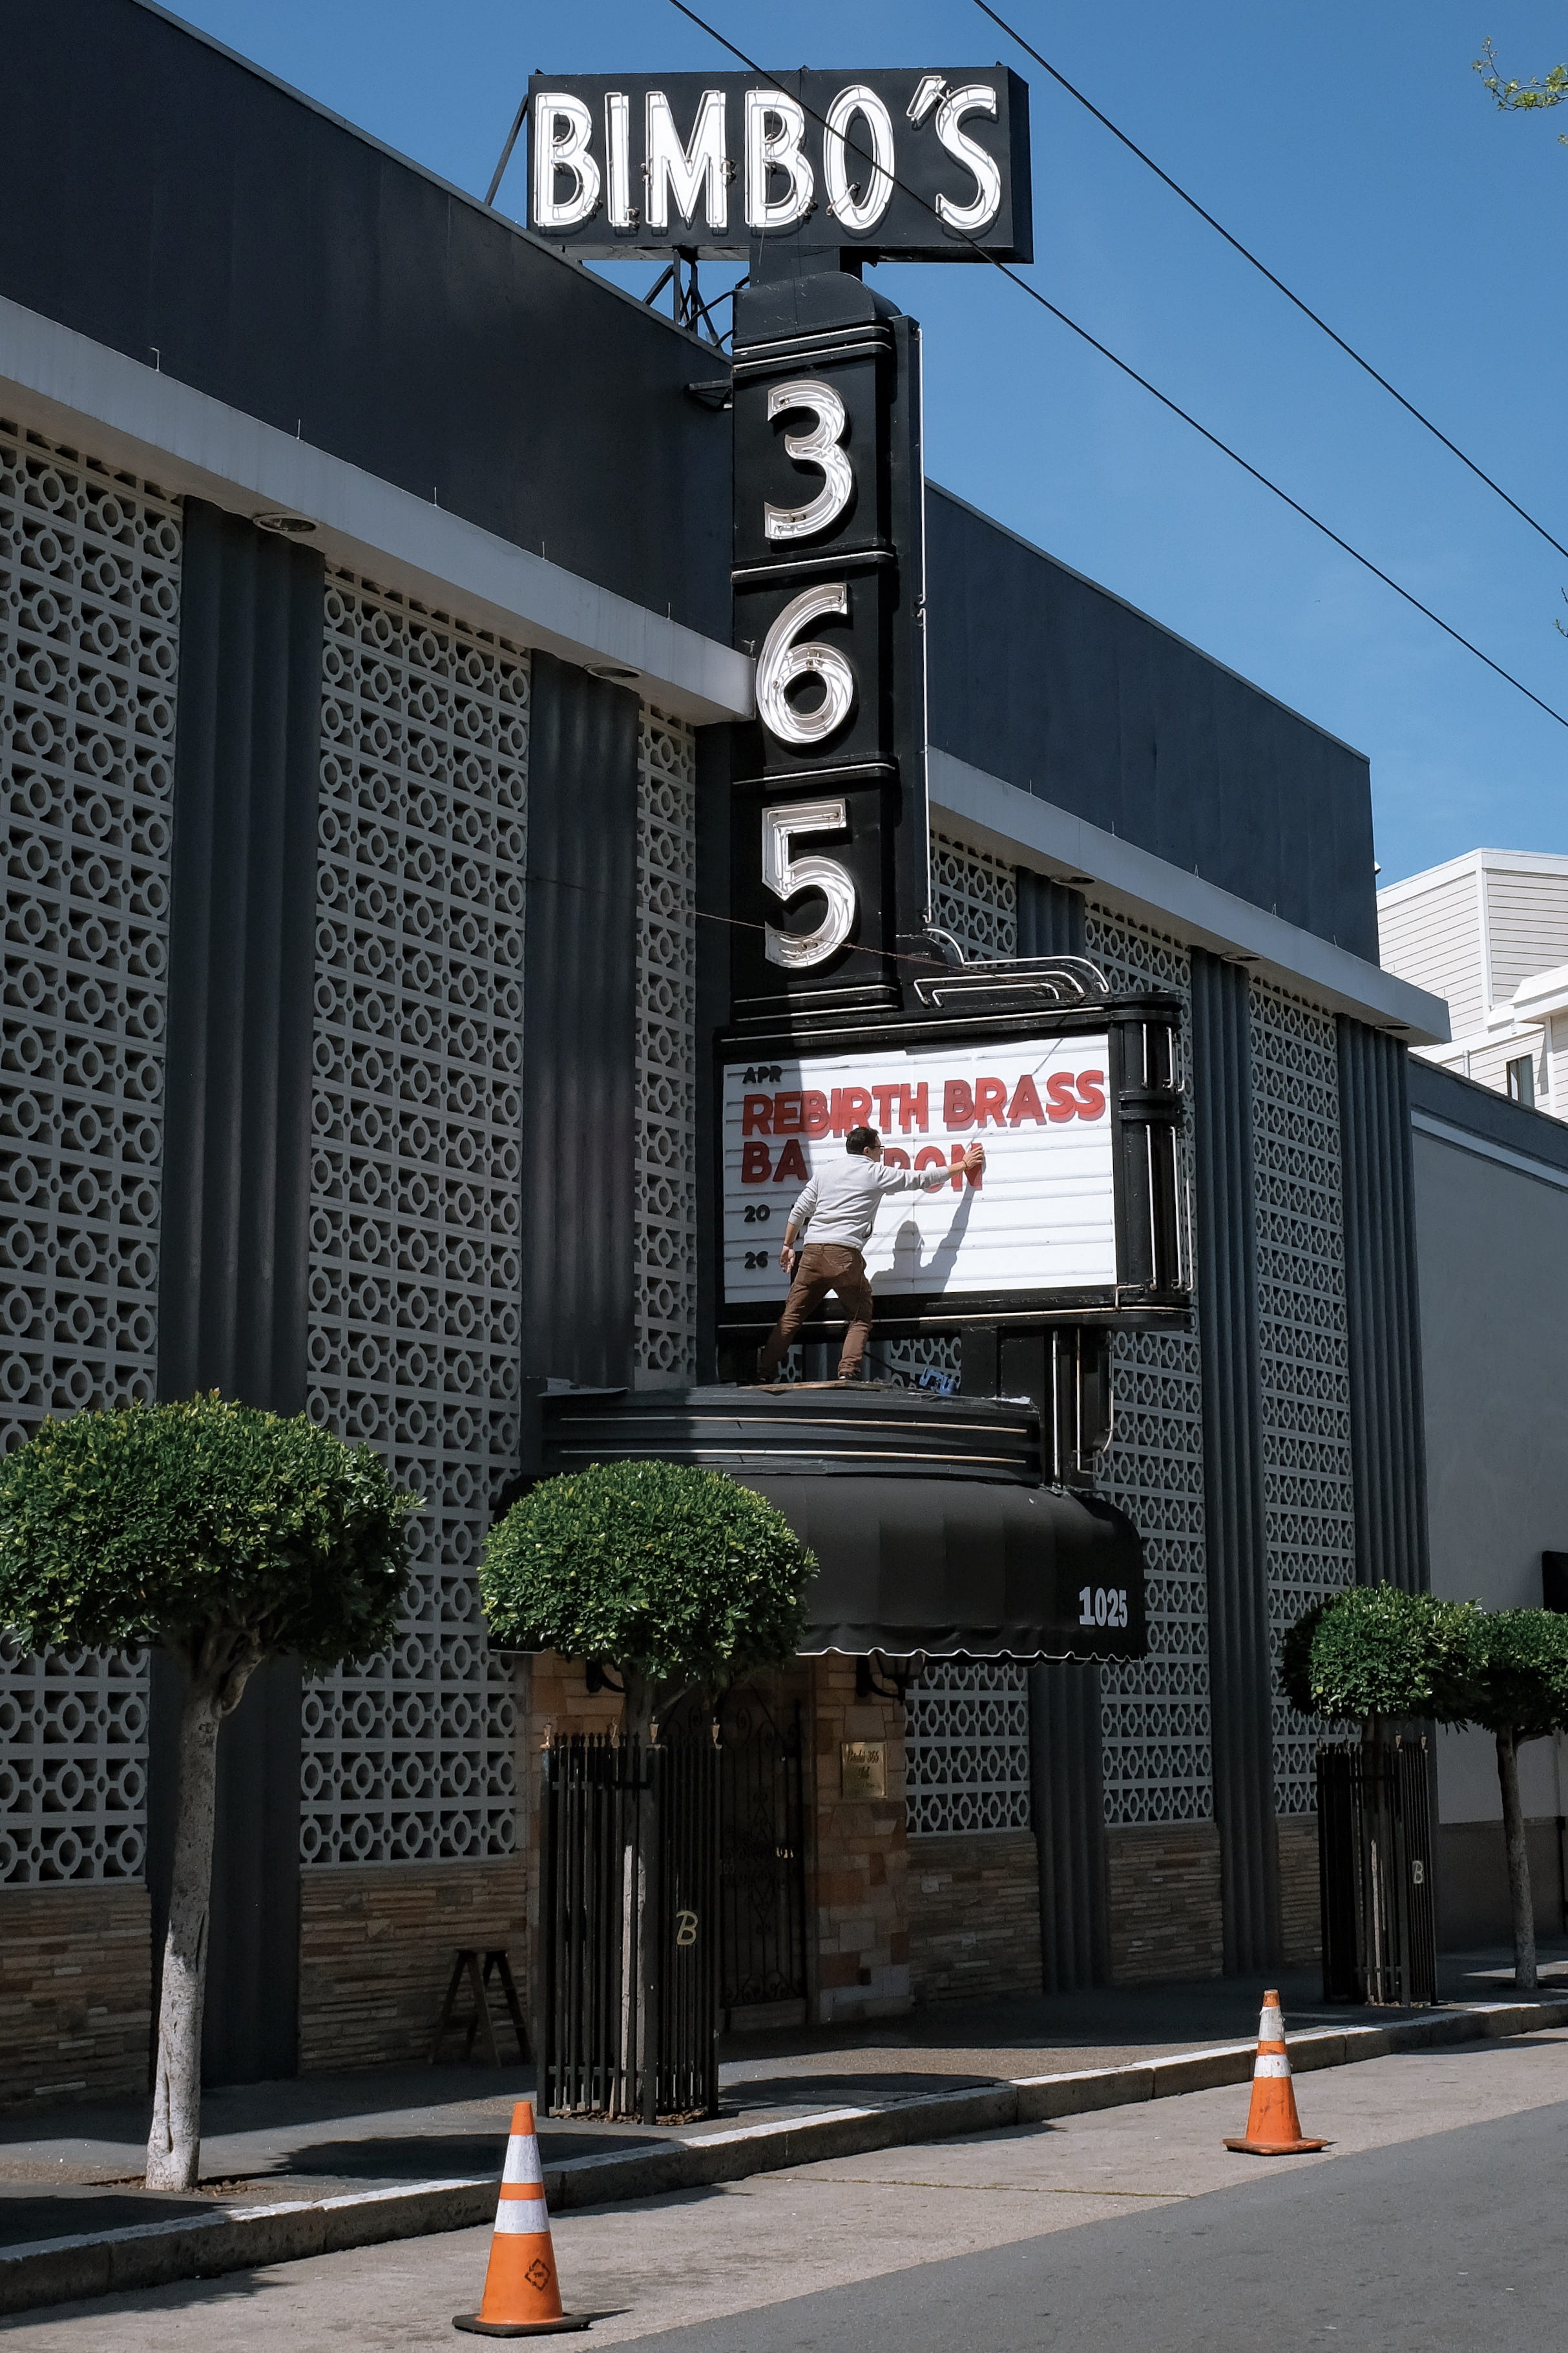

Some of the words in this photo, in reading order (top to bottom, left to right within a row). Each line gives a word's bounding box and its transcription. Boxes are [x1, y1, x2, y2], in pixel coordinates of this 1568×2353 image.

[534, 75, 1001, 230] BIMBO'S
[757, 380, 857, 969] 365
[742, 1065, 782, 1083] APR
[742, 1082, 928, 1137] REBIRTH
[943, 1070, 1106, 1129] BRASS
[744, 1204, 771, 1222] 20
[744, 1250, 769, 1269] 26
[1079, 1586, 1128, 1627] 1025
[1412, 1861, 1423, 1884] B
[676, 1910, 698, 1945] B
